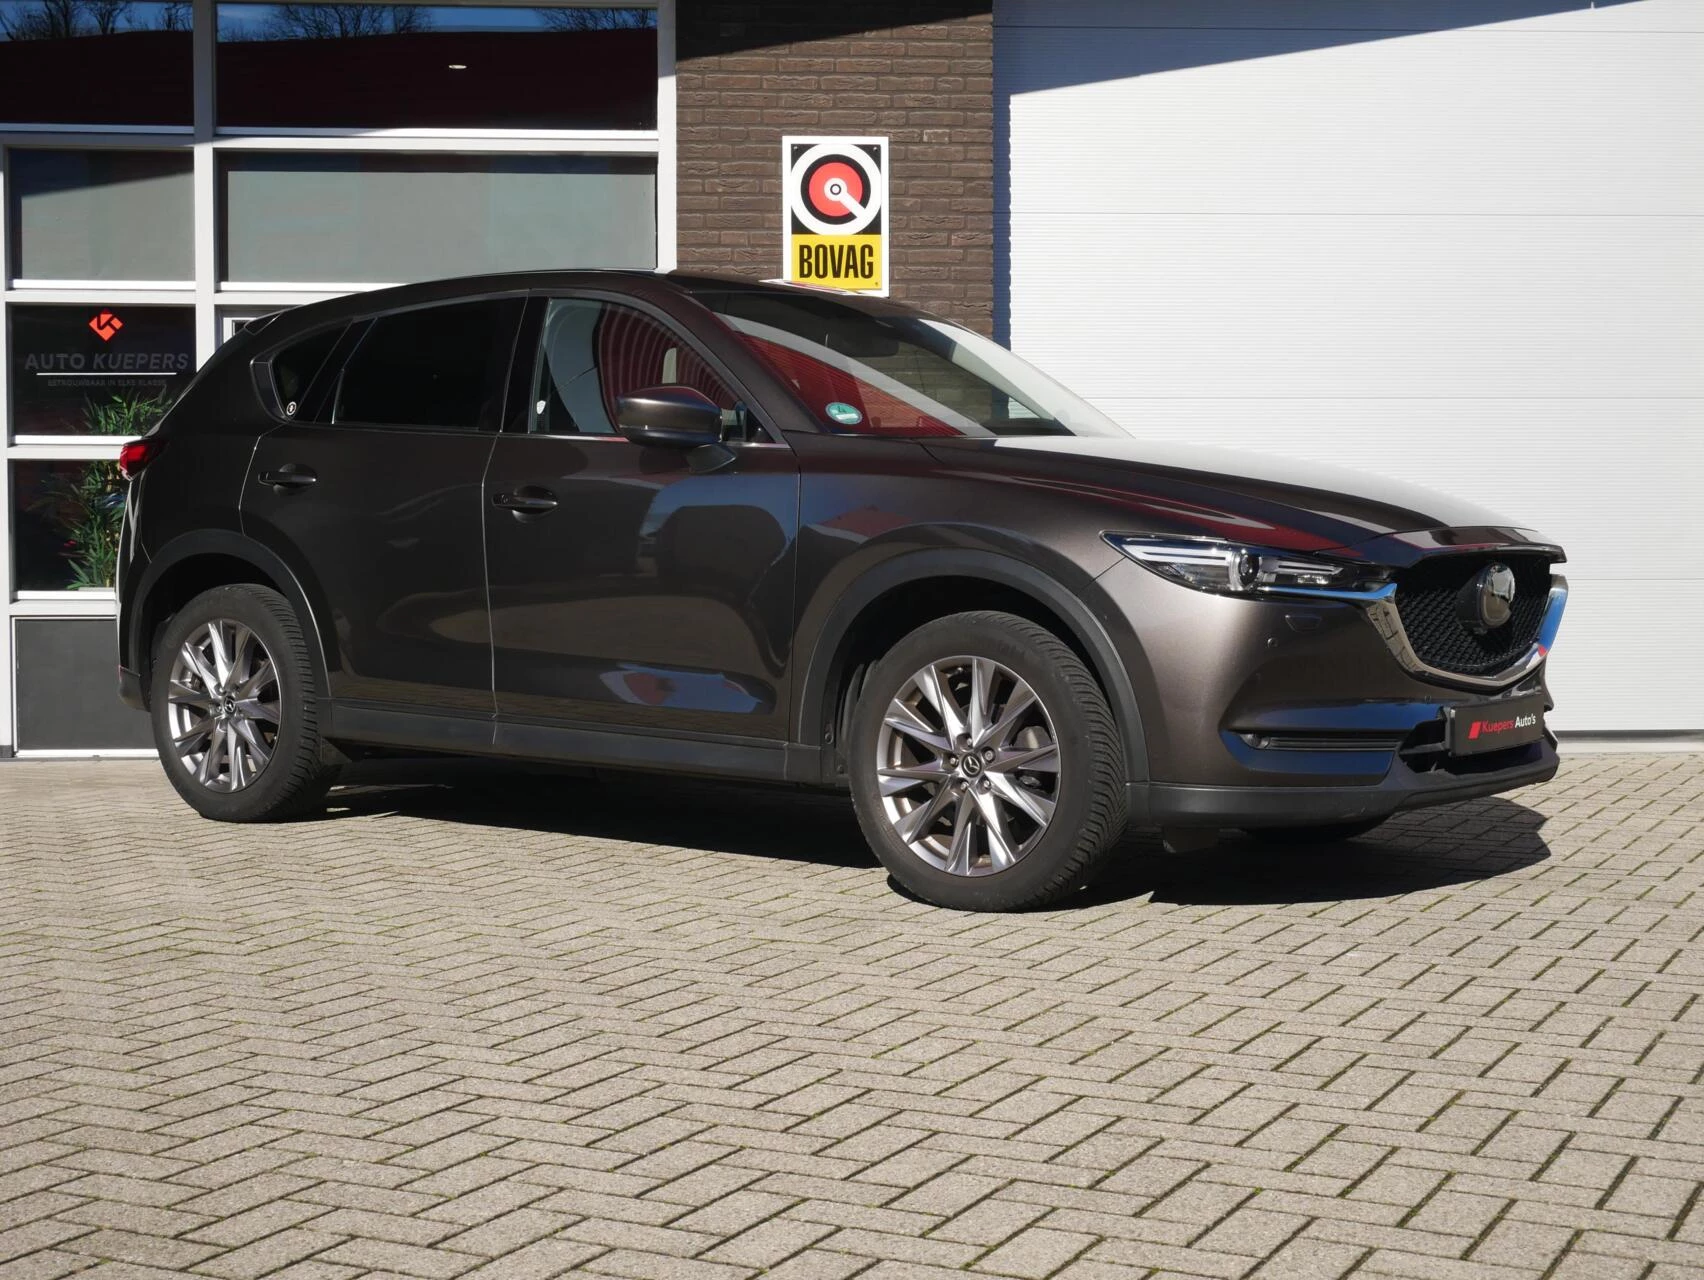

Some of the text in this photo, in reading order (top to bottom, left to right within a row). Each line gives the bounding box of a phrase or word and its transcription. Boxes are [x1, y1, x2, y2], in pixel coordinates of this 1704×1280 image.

[799, 244, 874, 279] BOVAG
[24, 353, 189, 370] AUTO KUEPERS
[1481, 713, 1537, 735] Kuepers Auto's
